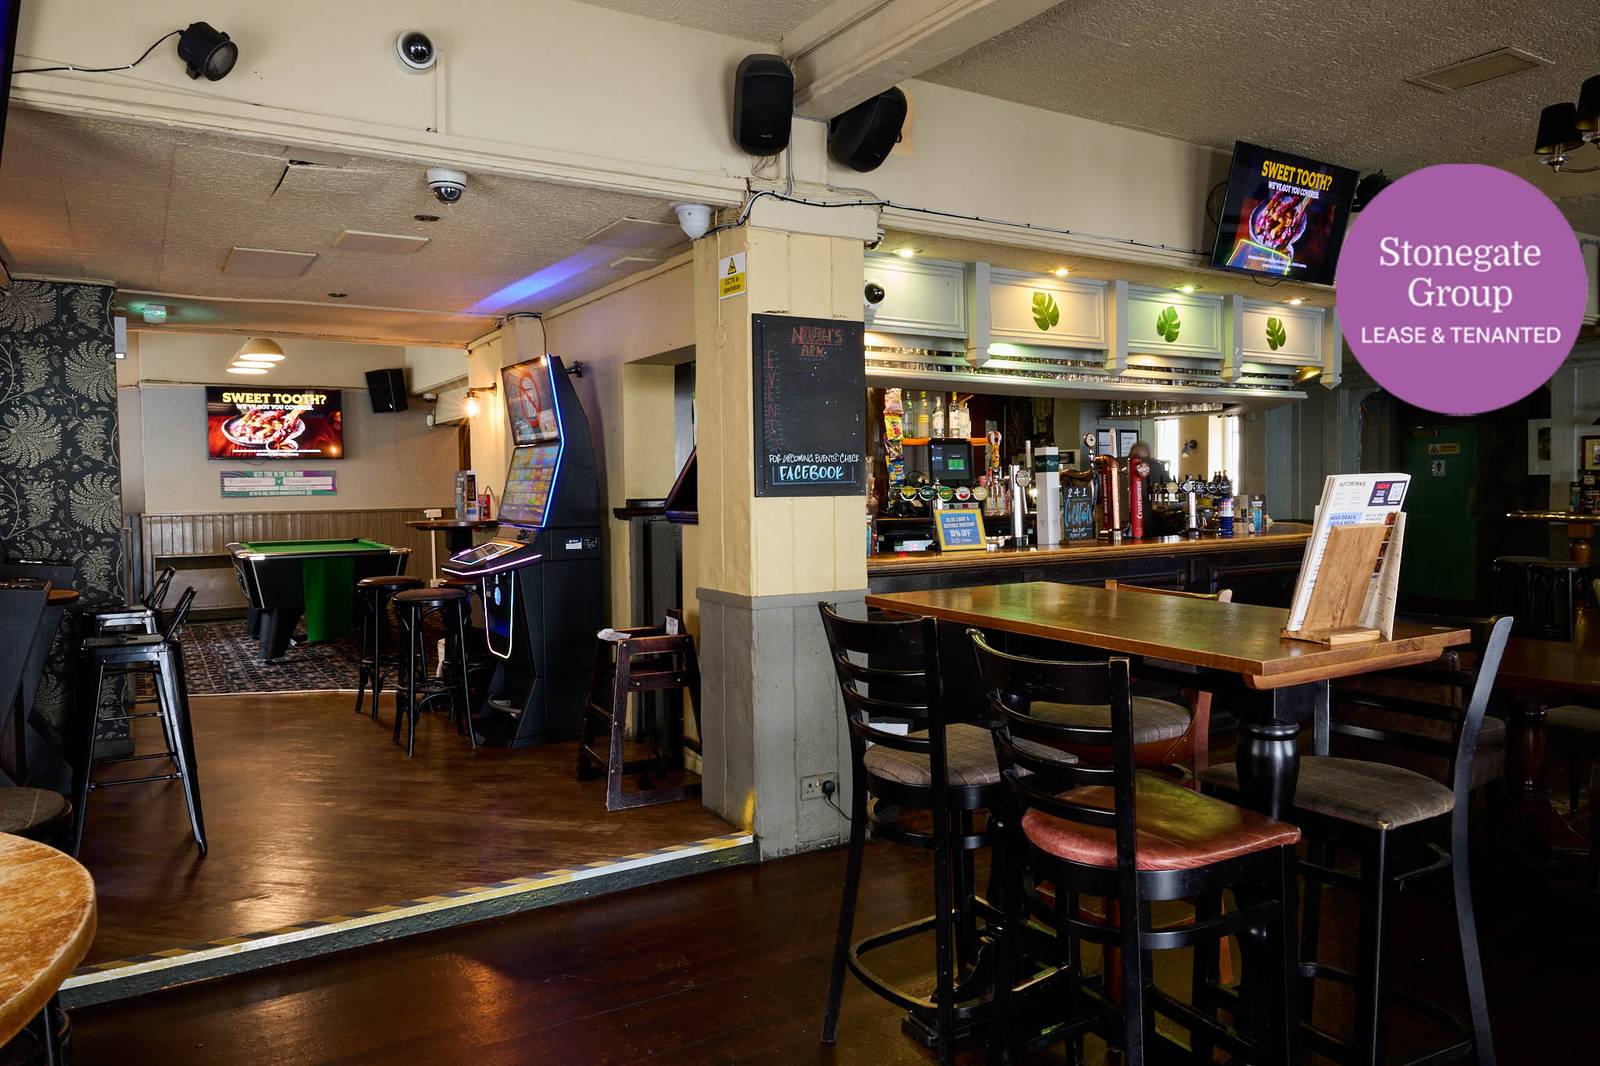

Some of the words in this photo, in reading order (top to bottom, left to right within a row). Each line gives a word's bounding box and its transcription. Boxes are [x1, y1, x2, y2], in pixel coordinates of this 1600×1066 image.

[1261, 160, 1296, 183] SWEET
[1296, 168, 1333, 191] TOOTH?
[222, 392, 271, 404] SWEET
[272, 393, 327, 405] TOOTH?
[769, 454, 782, 463] FOR
[782, 453, 814, 463] UPCOMING
[839, 453, 860, 463] CHECK
[779, 465, 844, 481] FACEBOOK
